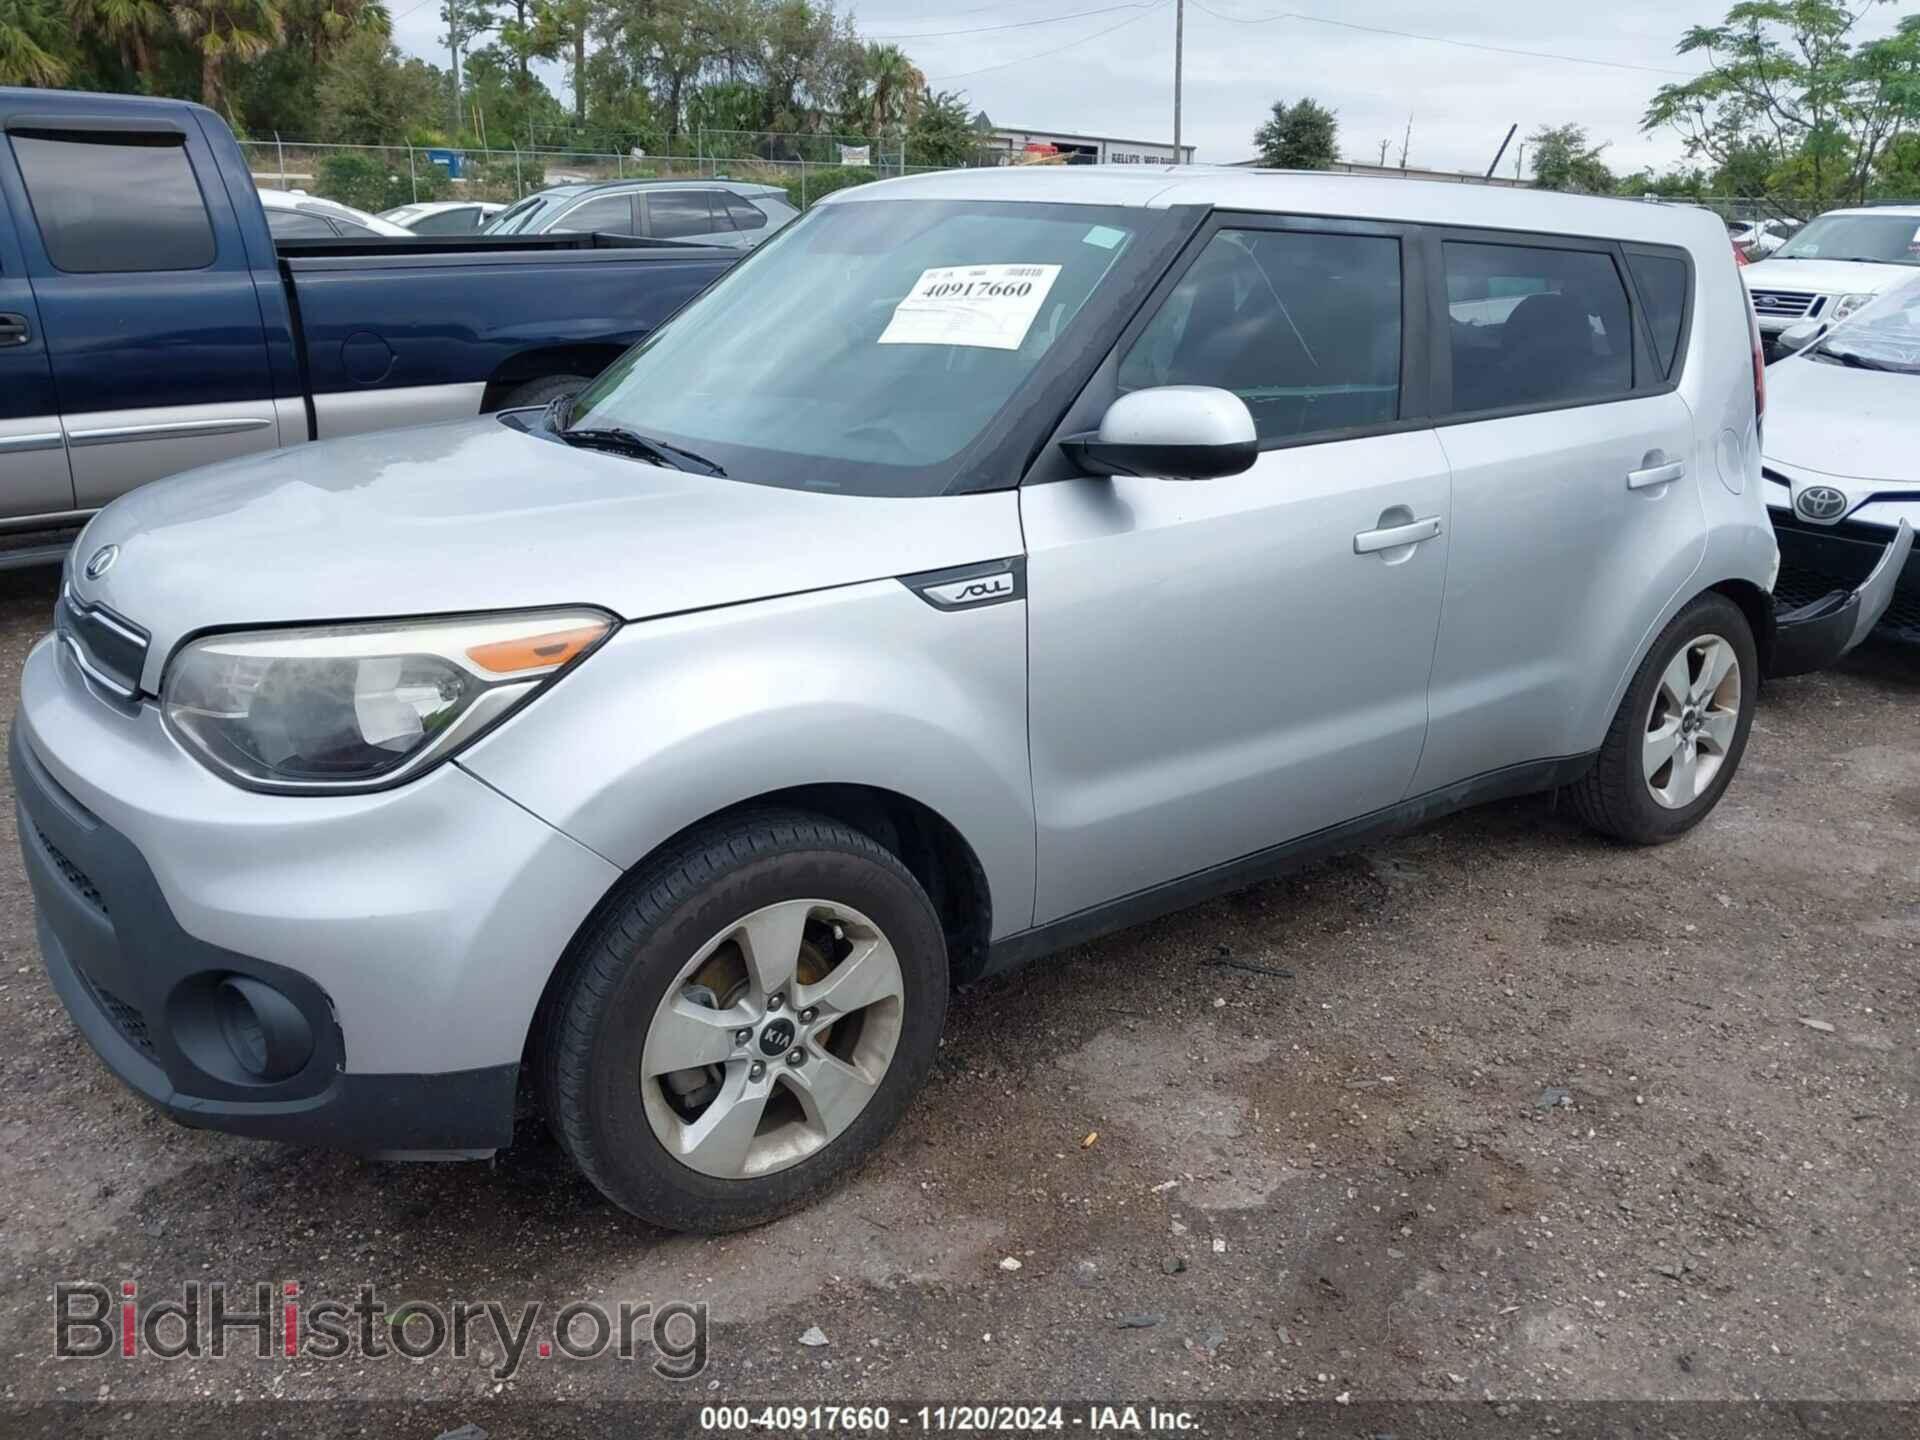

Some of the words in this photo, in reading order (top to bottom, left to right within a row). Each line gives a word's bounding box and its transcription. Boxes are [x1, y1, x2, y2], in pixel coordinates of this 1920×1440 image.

[922, 281, 1032, 298] 40917660
[955, 580, 1011, 600] SOUL
[764, 1028, 790, 1048] KIA
